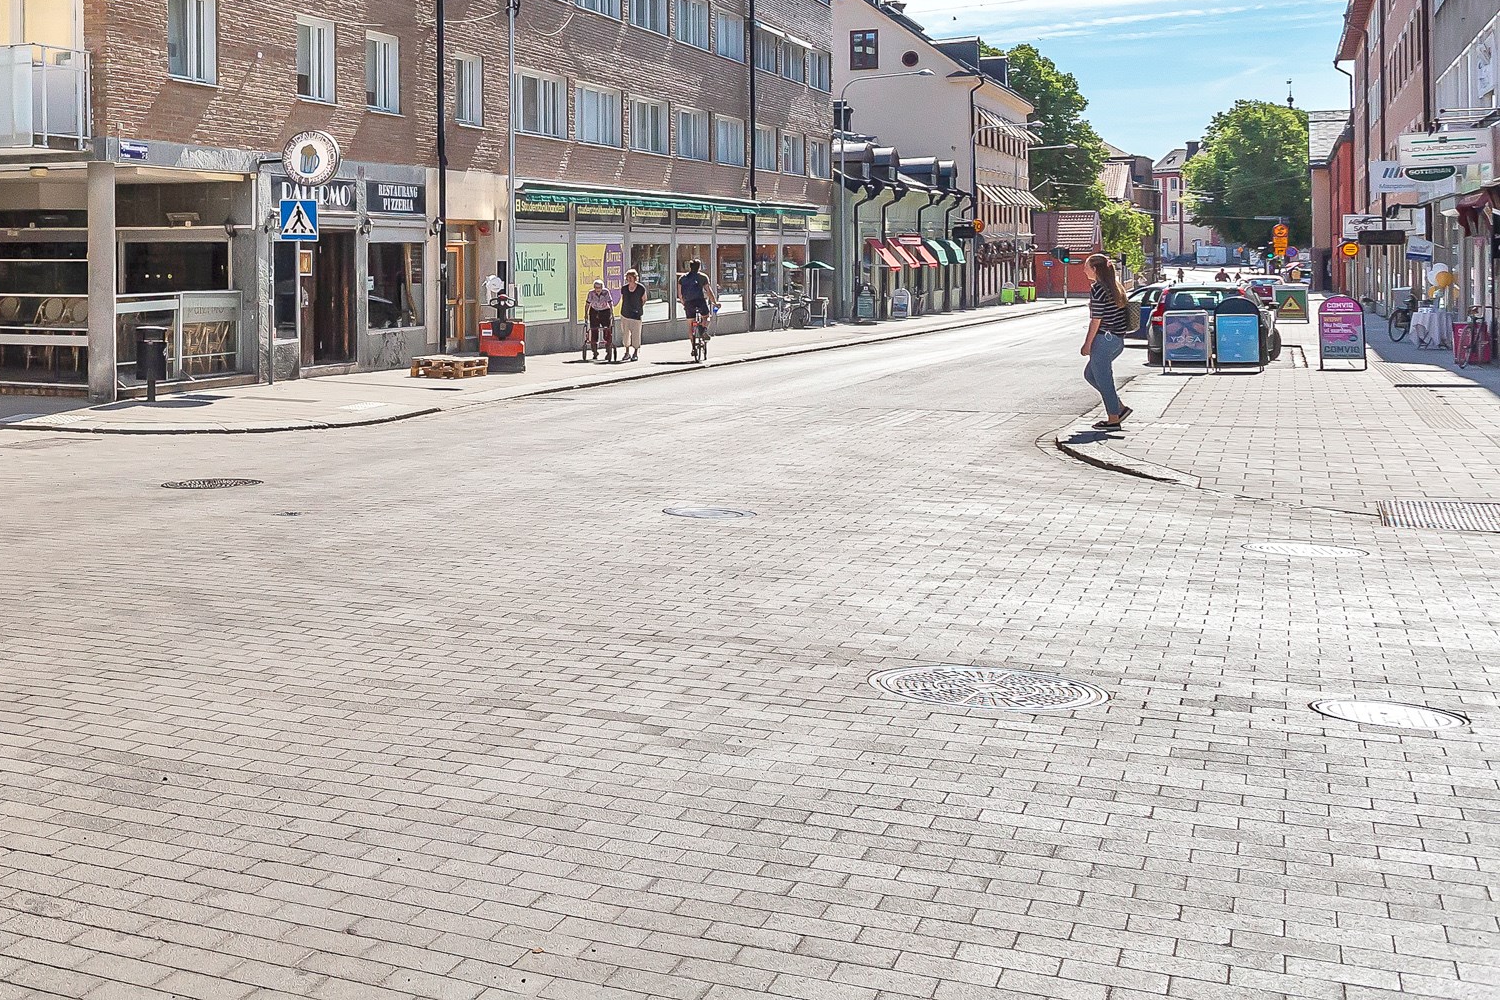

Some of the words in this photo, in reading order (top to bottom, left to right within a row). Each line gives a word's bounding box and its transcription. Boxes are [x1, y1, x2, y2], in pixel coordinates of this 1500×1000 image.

[378, 184, 418, 198] RESTAURANG
[383, 198, 414, 211] PIZZERIA
[515, 251, 556, 277] Mångsidig
[533, 276, 545, 297] du.
[1324, 345, 1361, 353] COMVIQ
